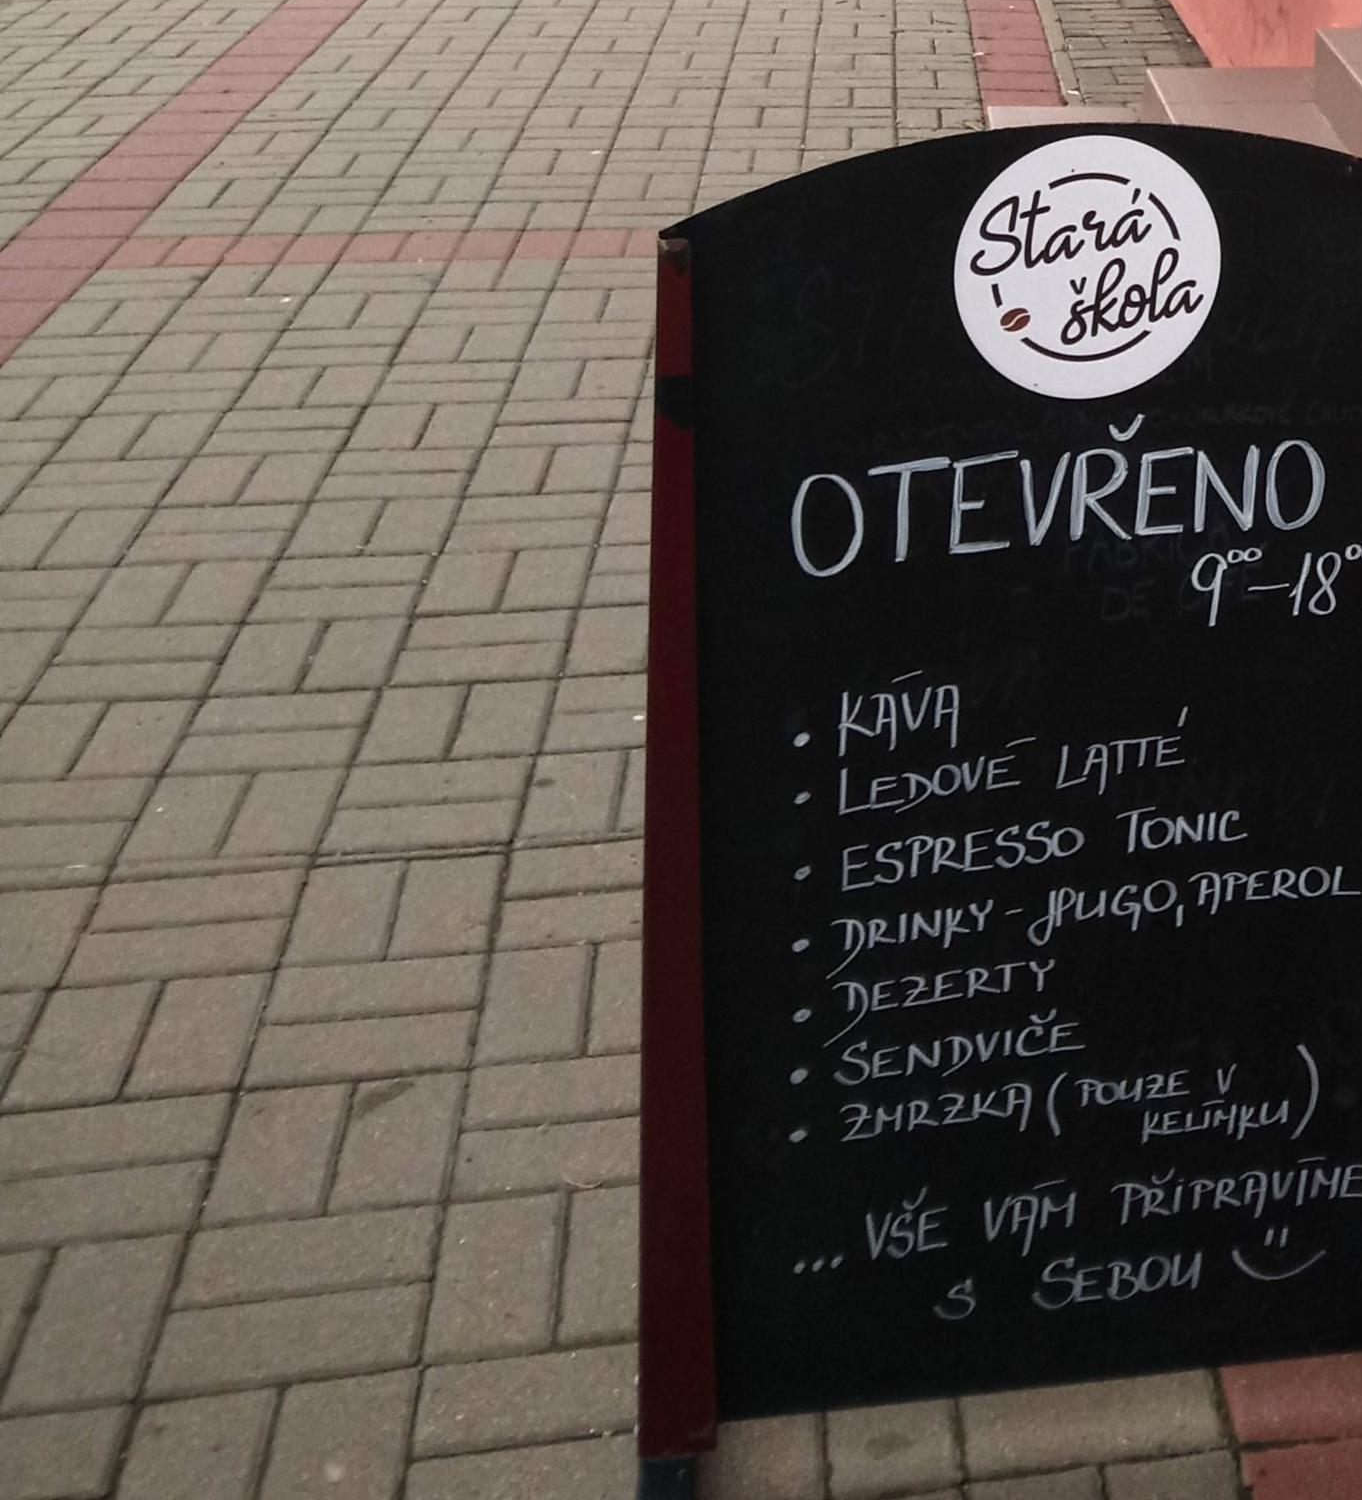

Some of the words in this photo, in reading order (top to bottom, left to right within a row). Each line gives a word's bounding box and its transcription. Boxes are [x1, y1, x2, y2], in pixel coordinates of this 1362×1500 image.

[970, 187, 1152, 276] Stará
[1060, 247, 1204, 345] škola
[791, 413, 1326, 577] OTEVŘENO
[838, 670, 960, 757] KÁVA
[838, 737, 1036, 815] LEDOVÉ
[1056, 706, 1188, 795] LATTÉ
[842, 821, 1085, 892] ESPRESSO
[1116, 806, 1249, 854] TONIC
[826, 898, 994, 980] DRINKY
[1188, 865, 1362, 916] APEROL
[824, 959, 1055, 1048] DEZERTY
[834, 1008, 1086, 1087] SENDVIČE
[840, 1081, 1033, 1142] ZMRZKA
[983, 1179, 1077, 1257] VÁM
[1031, 1251, 1202, 1310] SEBOU
